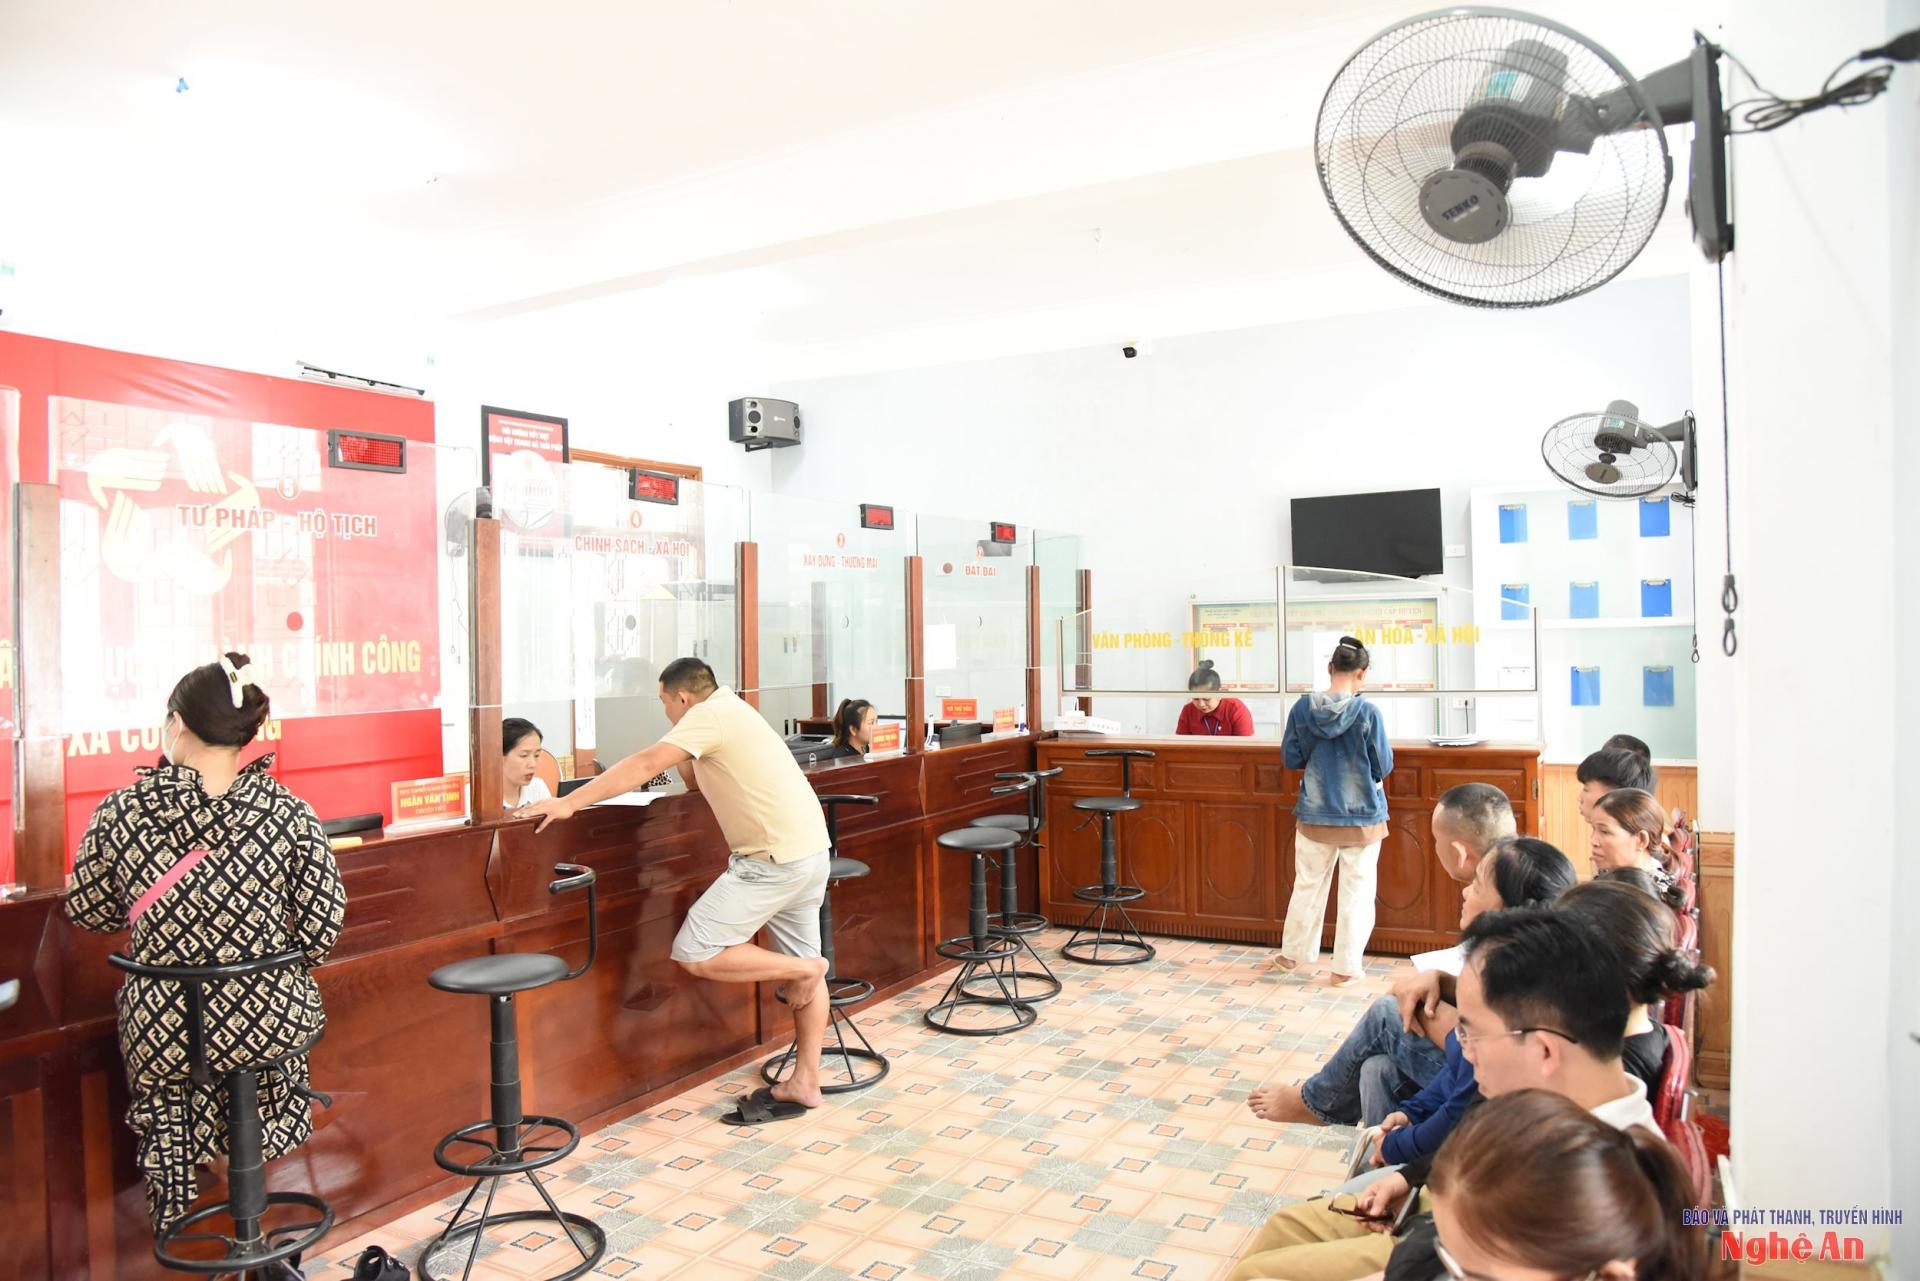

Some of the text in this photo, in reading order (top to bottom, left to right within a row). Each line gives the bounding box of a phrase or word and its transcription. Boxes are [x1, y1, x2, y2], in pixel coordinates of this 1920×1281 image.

[176, 504, 210, 527] TƯ
[214, 506, 276, 529] PHÁP
[297, 508, 327, 539] HỘ
[331, 513, 378, 540] TỊCH
[1092, 630, 1120, 649] VĂN
[1123, 629, 1172, 649] PHÒNG
[1183, 629, 1230, 648] THỐNG
[1345, 624, 1377, 645] ĂN
[361, 633, 422, 676] CÔNG
